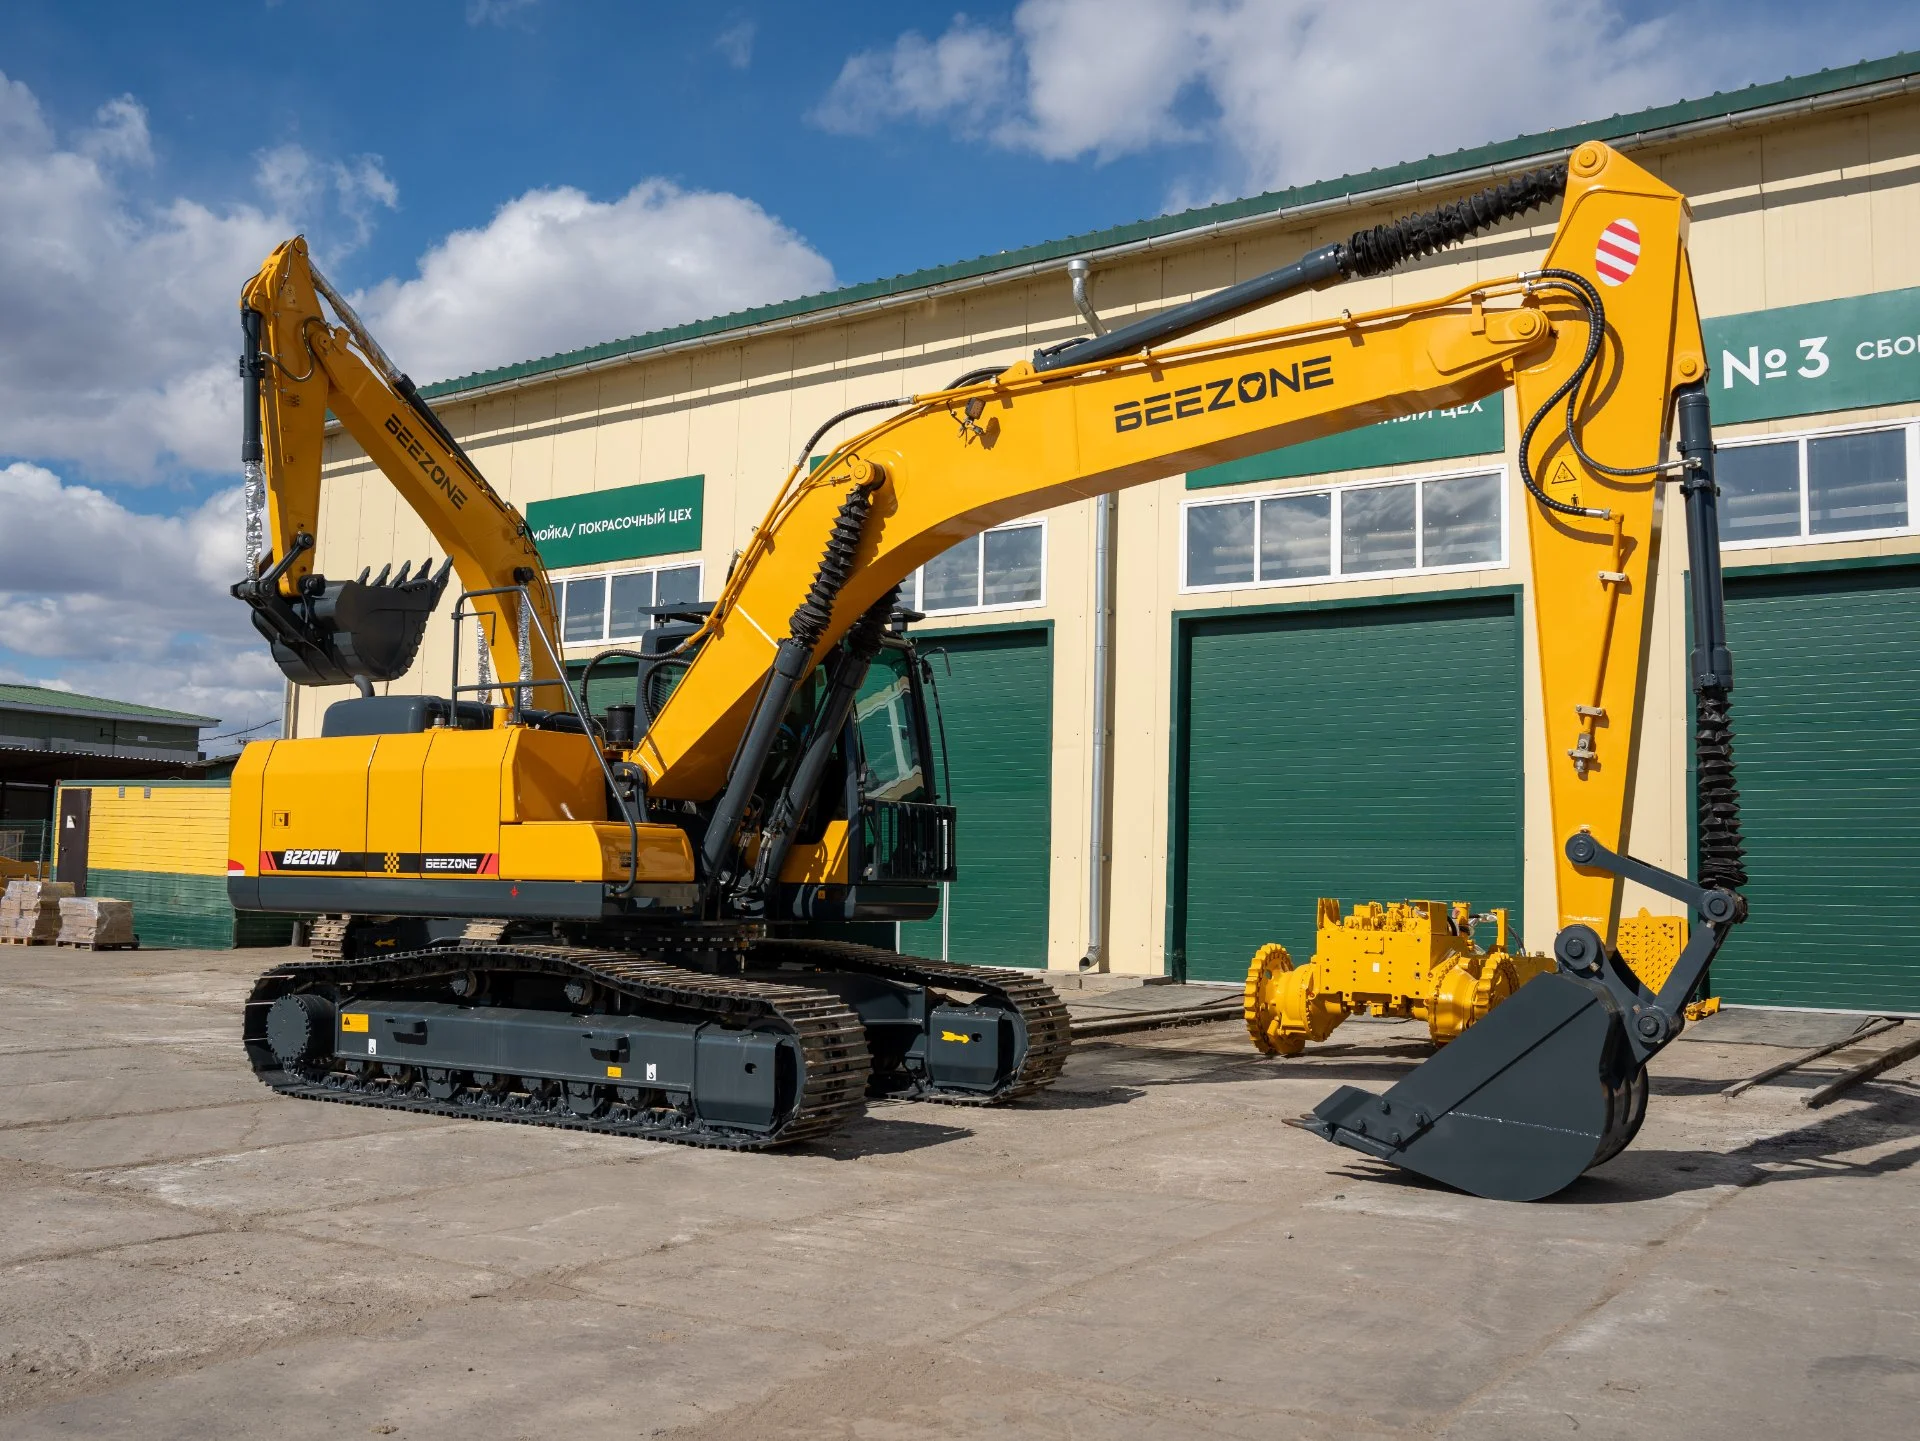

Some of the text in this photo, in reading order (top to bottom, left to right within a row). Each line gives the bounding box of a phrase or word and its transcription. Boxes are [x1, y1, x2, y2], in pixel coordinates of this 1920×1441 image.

[1797, 336, 1830, 379] 3
[1855, 334, 1920, 360] СБО
[1114, 355, 1334, 433] BEEZONE
[384, 412, 469, 512] BEEZONE
[578, 507, 666, 536] ПОКРАСОЧНЫЙ
[668, 507, 692, 524] ЦЕХ
[282, 849, 341, 866] B220EW
[425, 858, 478, 869] BEEZONE
